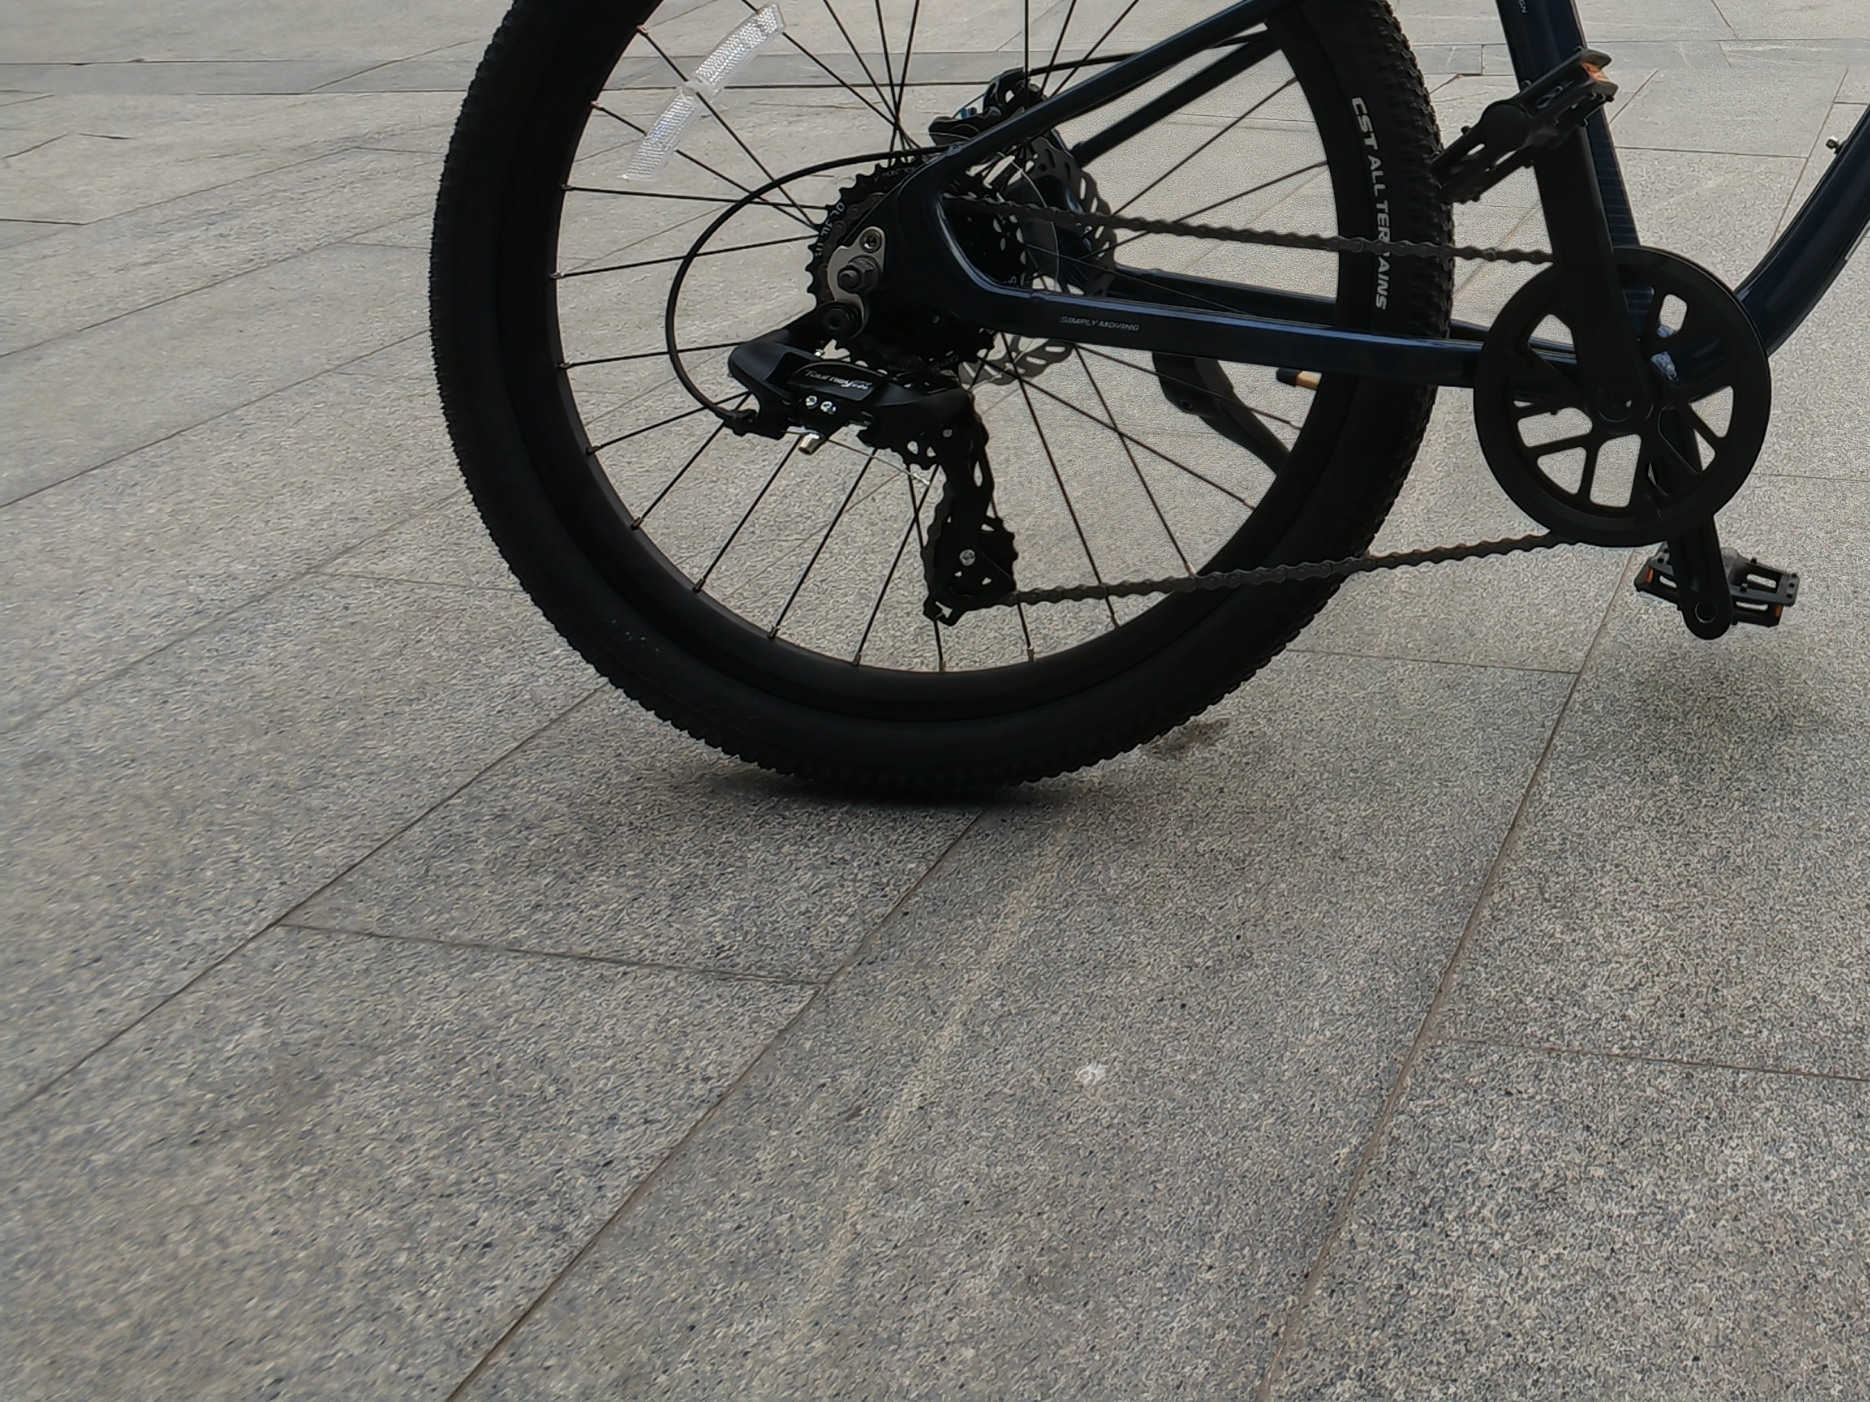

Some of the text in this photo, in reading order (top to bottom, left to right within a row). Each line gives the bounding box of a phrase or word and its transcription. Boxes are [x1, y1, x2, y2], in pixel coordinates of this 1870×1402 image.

[1351, 97, 1391, 311] CST ALL TERAINS
[1060, 316, 1140, 332] SIMPLY MOVING
